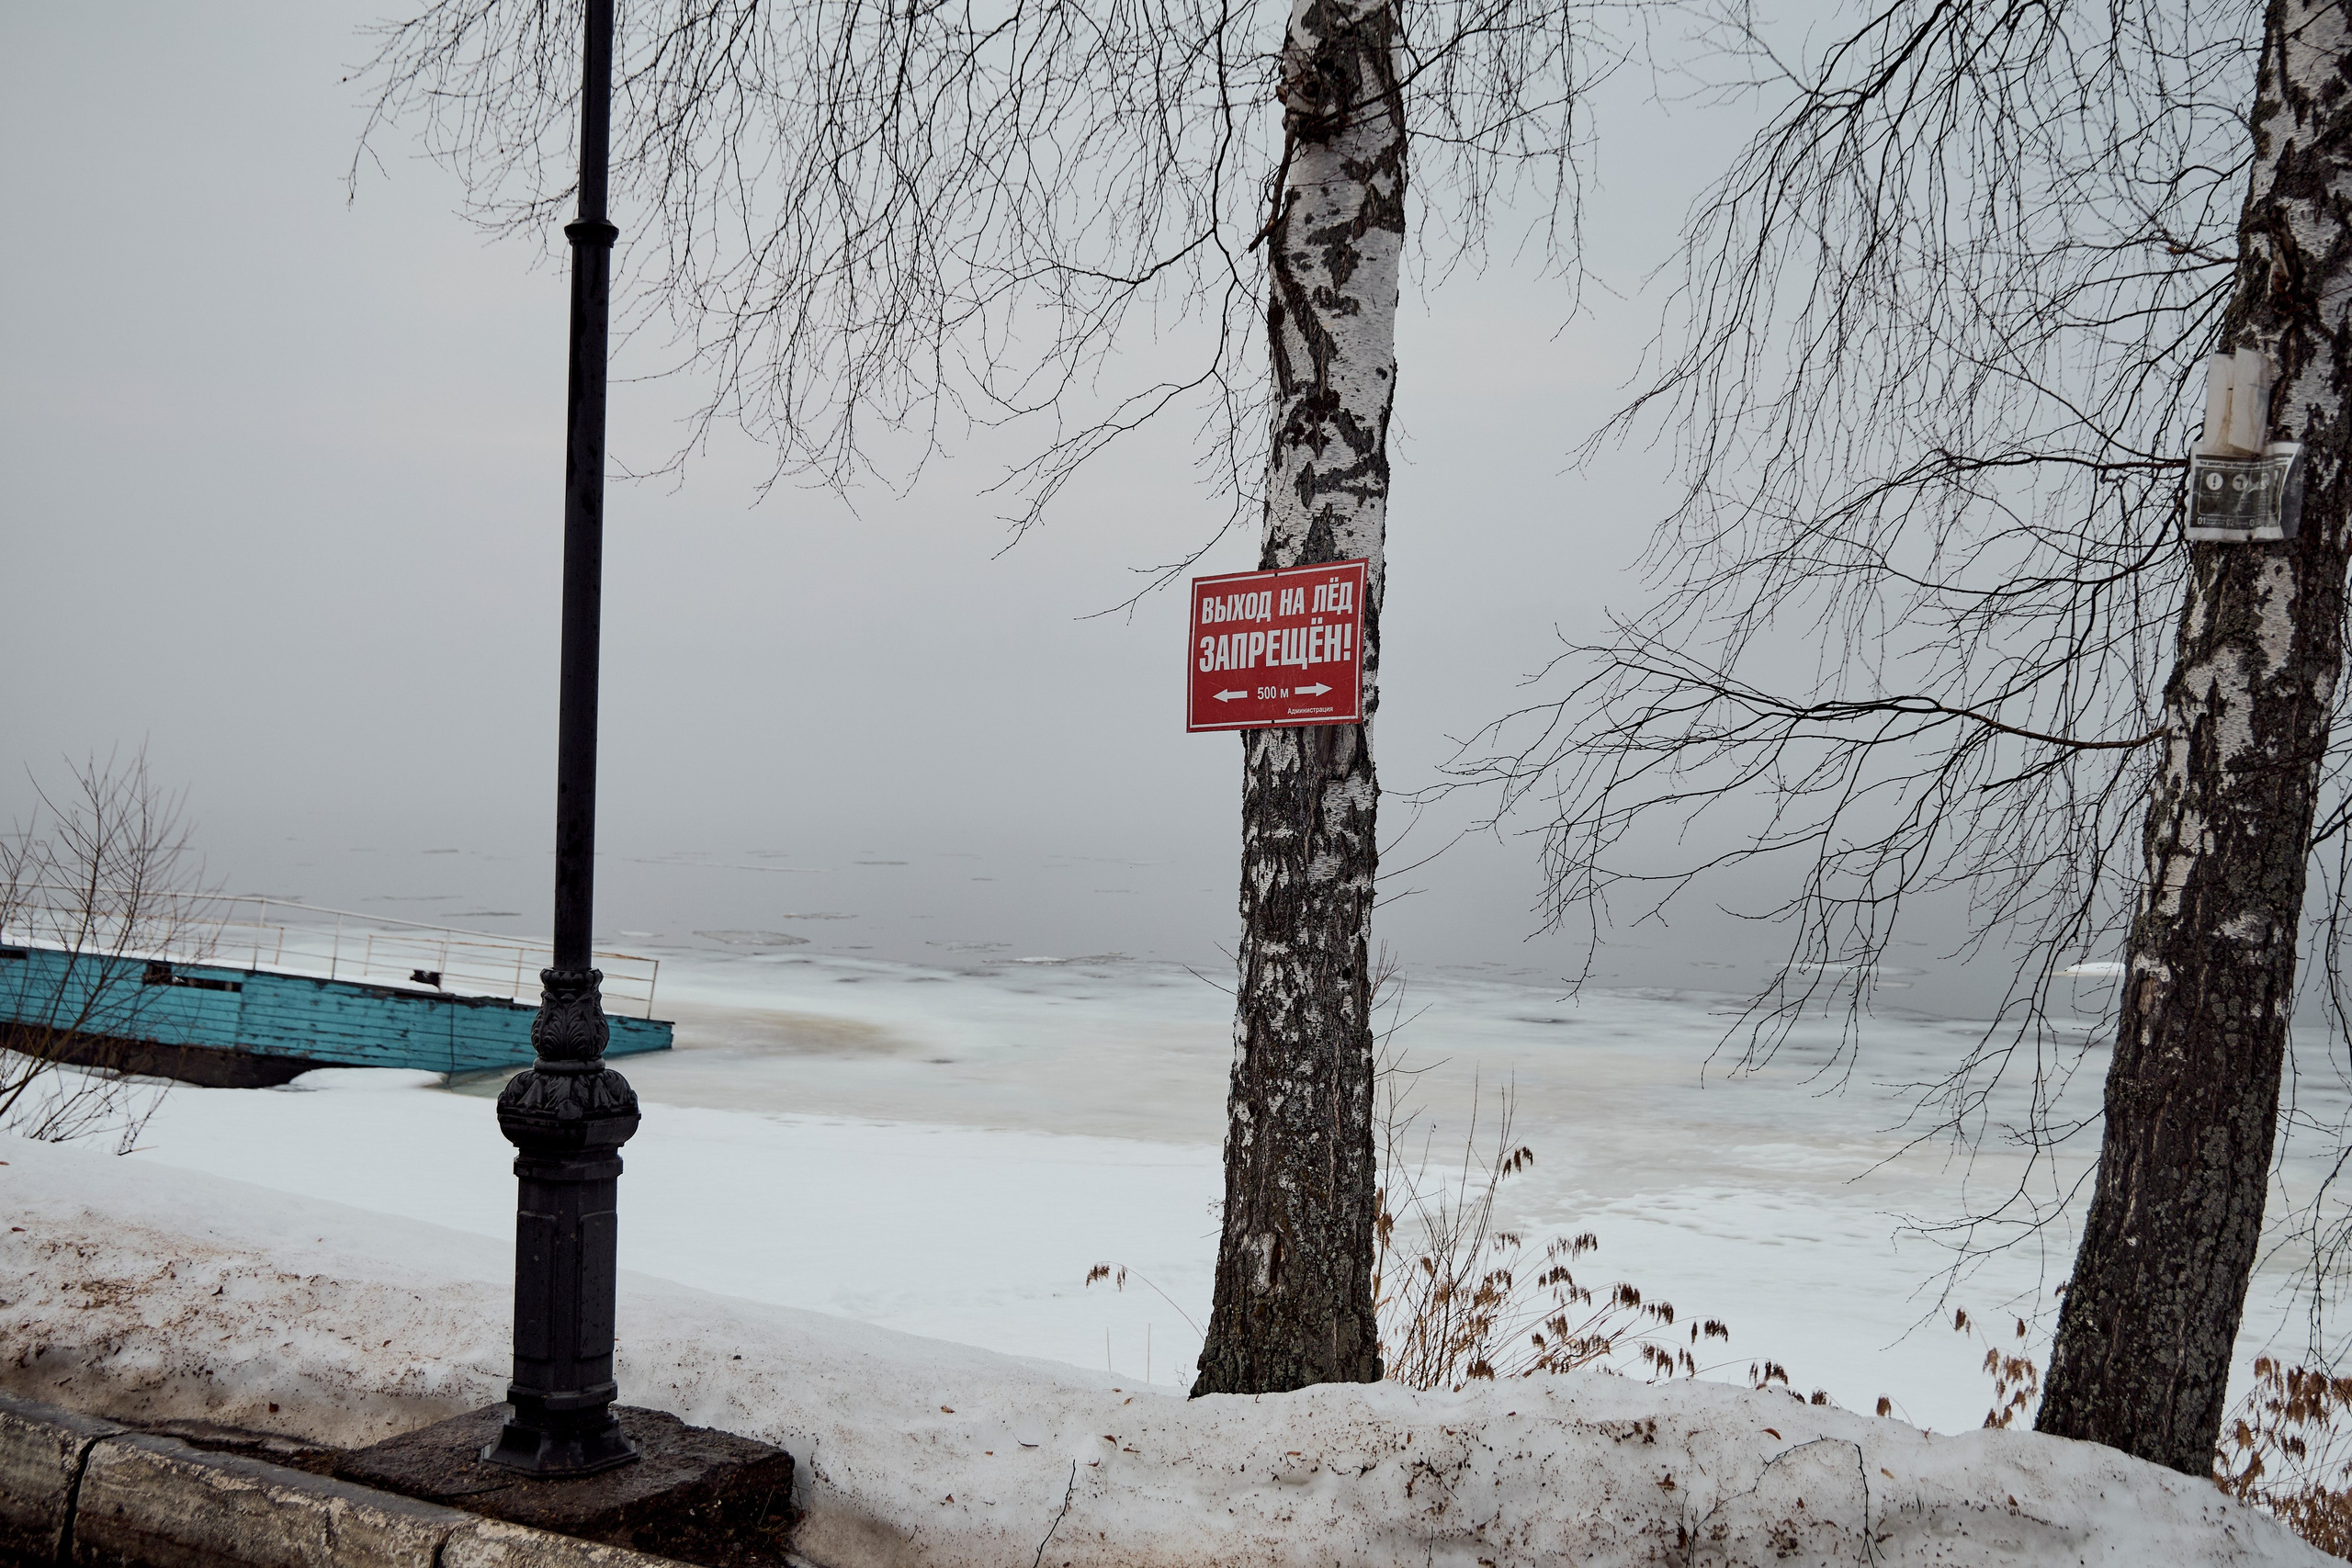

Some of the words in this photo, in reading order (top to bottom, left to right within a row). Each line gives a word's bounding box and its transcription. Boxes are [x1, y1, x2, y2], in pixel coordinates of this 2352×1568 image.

[2197, 516, 2206, 525] 01
[1201, 591, 1272, 625] ВЫХОД
[1279, 587, 1305, 616] НА
[1311, 577, 1353, 615] ЛЁД
[1199, 616, 1352, 673] ЗАПРЕЩЁН!
[1257, 685, 1277, 700] 500
[1287, 705, 1334, 715] Администрация
